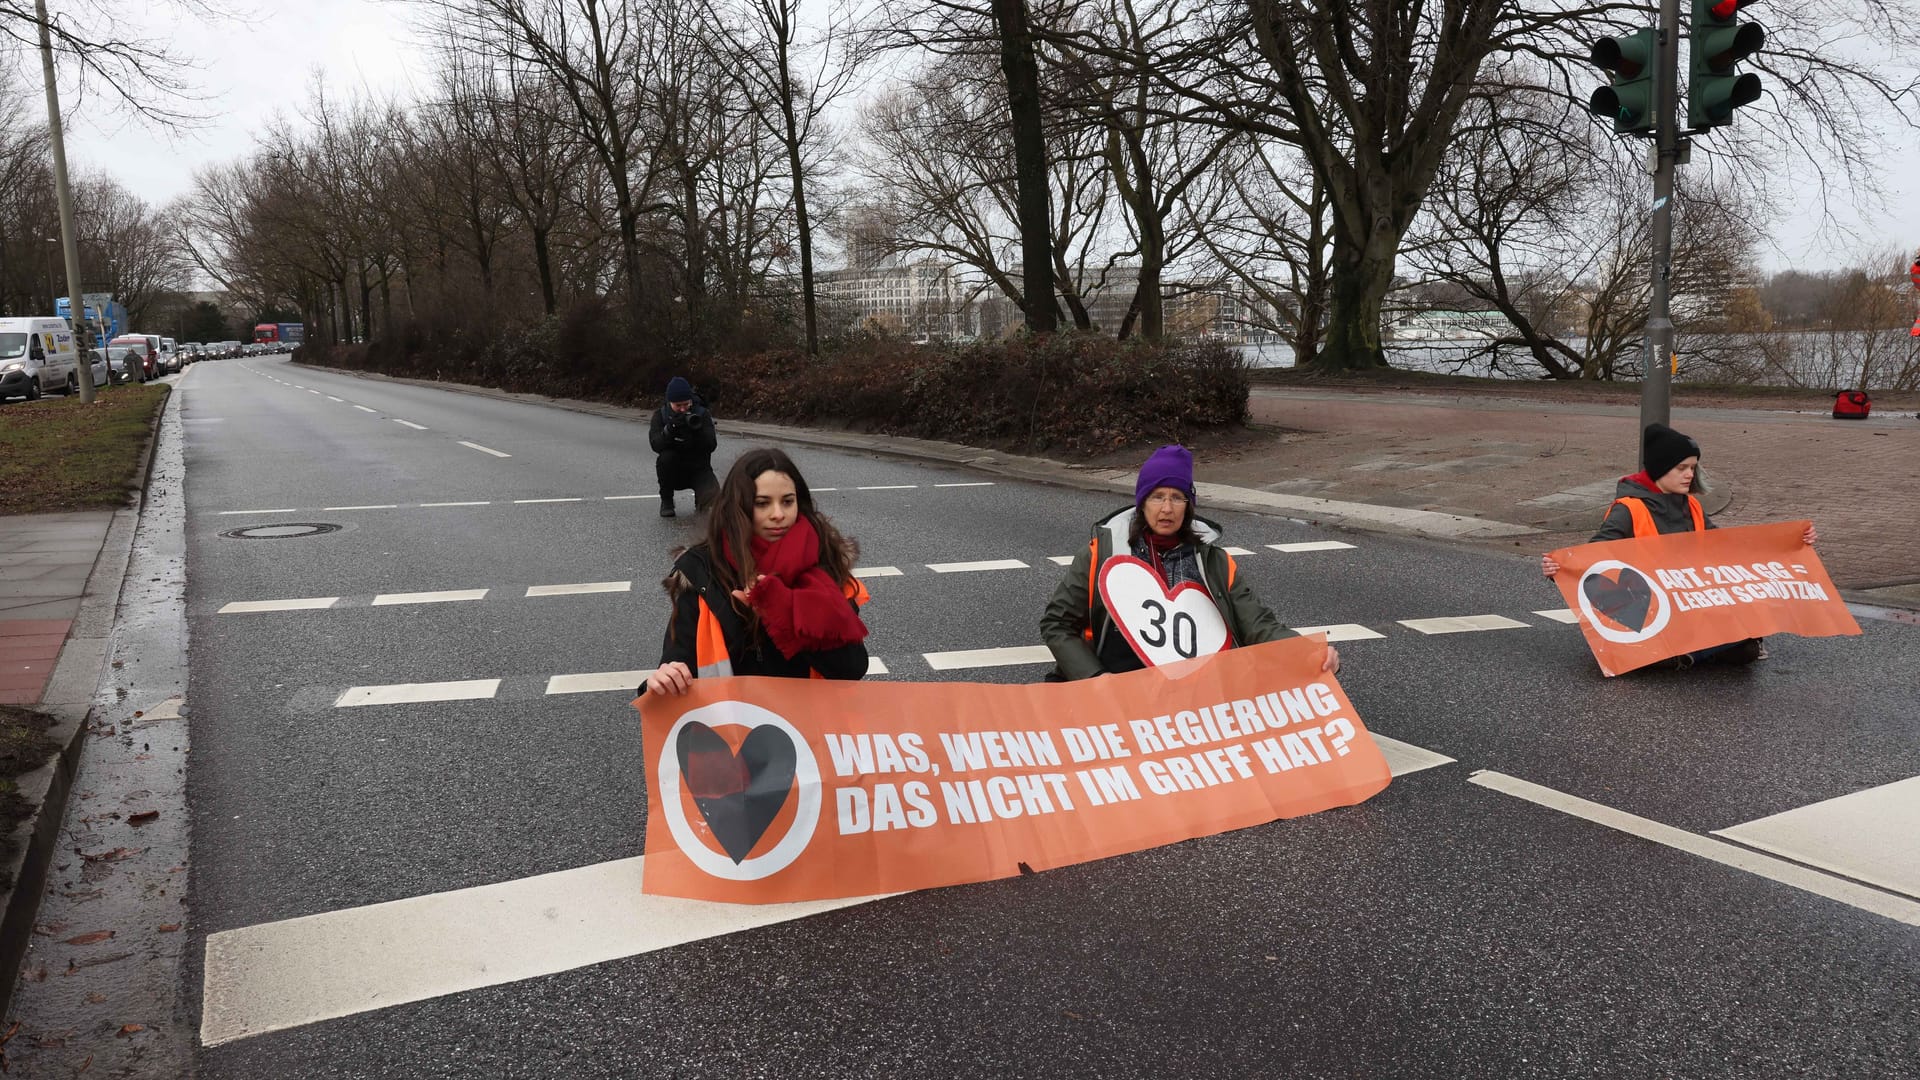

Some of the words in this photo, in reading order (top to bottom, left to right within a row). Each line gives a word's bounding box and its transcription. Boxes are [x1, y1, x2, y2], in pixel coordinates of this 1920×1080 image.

[1655, 567, 1712, 590] ART.
[1703, 564, 1761, 585] 20A
[1752, 561, 1794, 580] GG
[1672, 586, 1737, 612] LEBEN
[1139, 599, 1198, 659] 30
[824, 732, 940, 777] WAS,
[938, 730, 1062, 773] WENN
[1060, 723, 1132, 763] DIE
[1128, 682, 1342, 755] REGIERUNG
[835, 780, 938, 836] DAS
[939, 773, 1075, 825] NICHT
[1076, 765, 1142, 806] IM
[1138, 743, 1254, 796] GRIFF
[1250, 717, 1356, 775] HAT?
